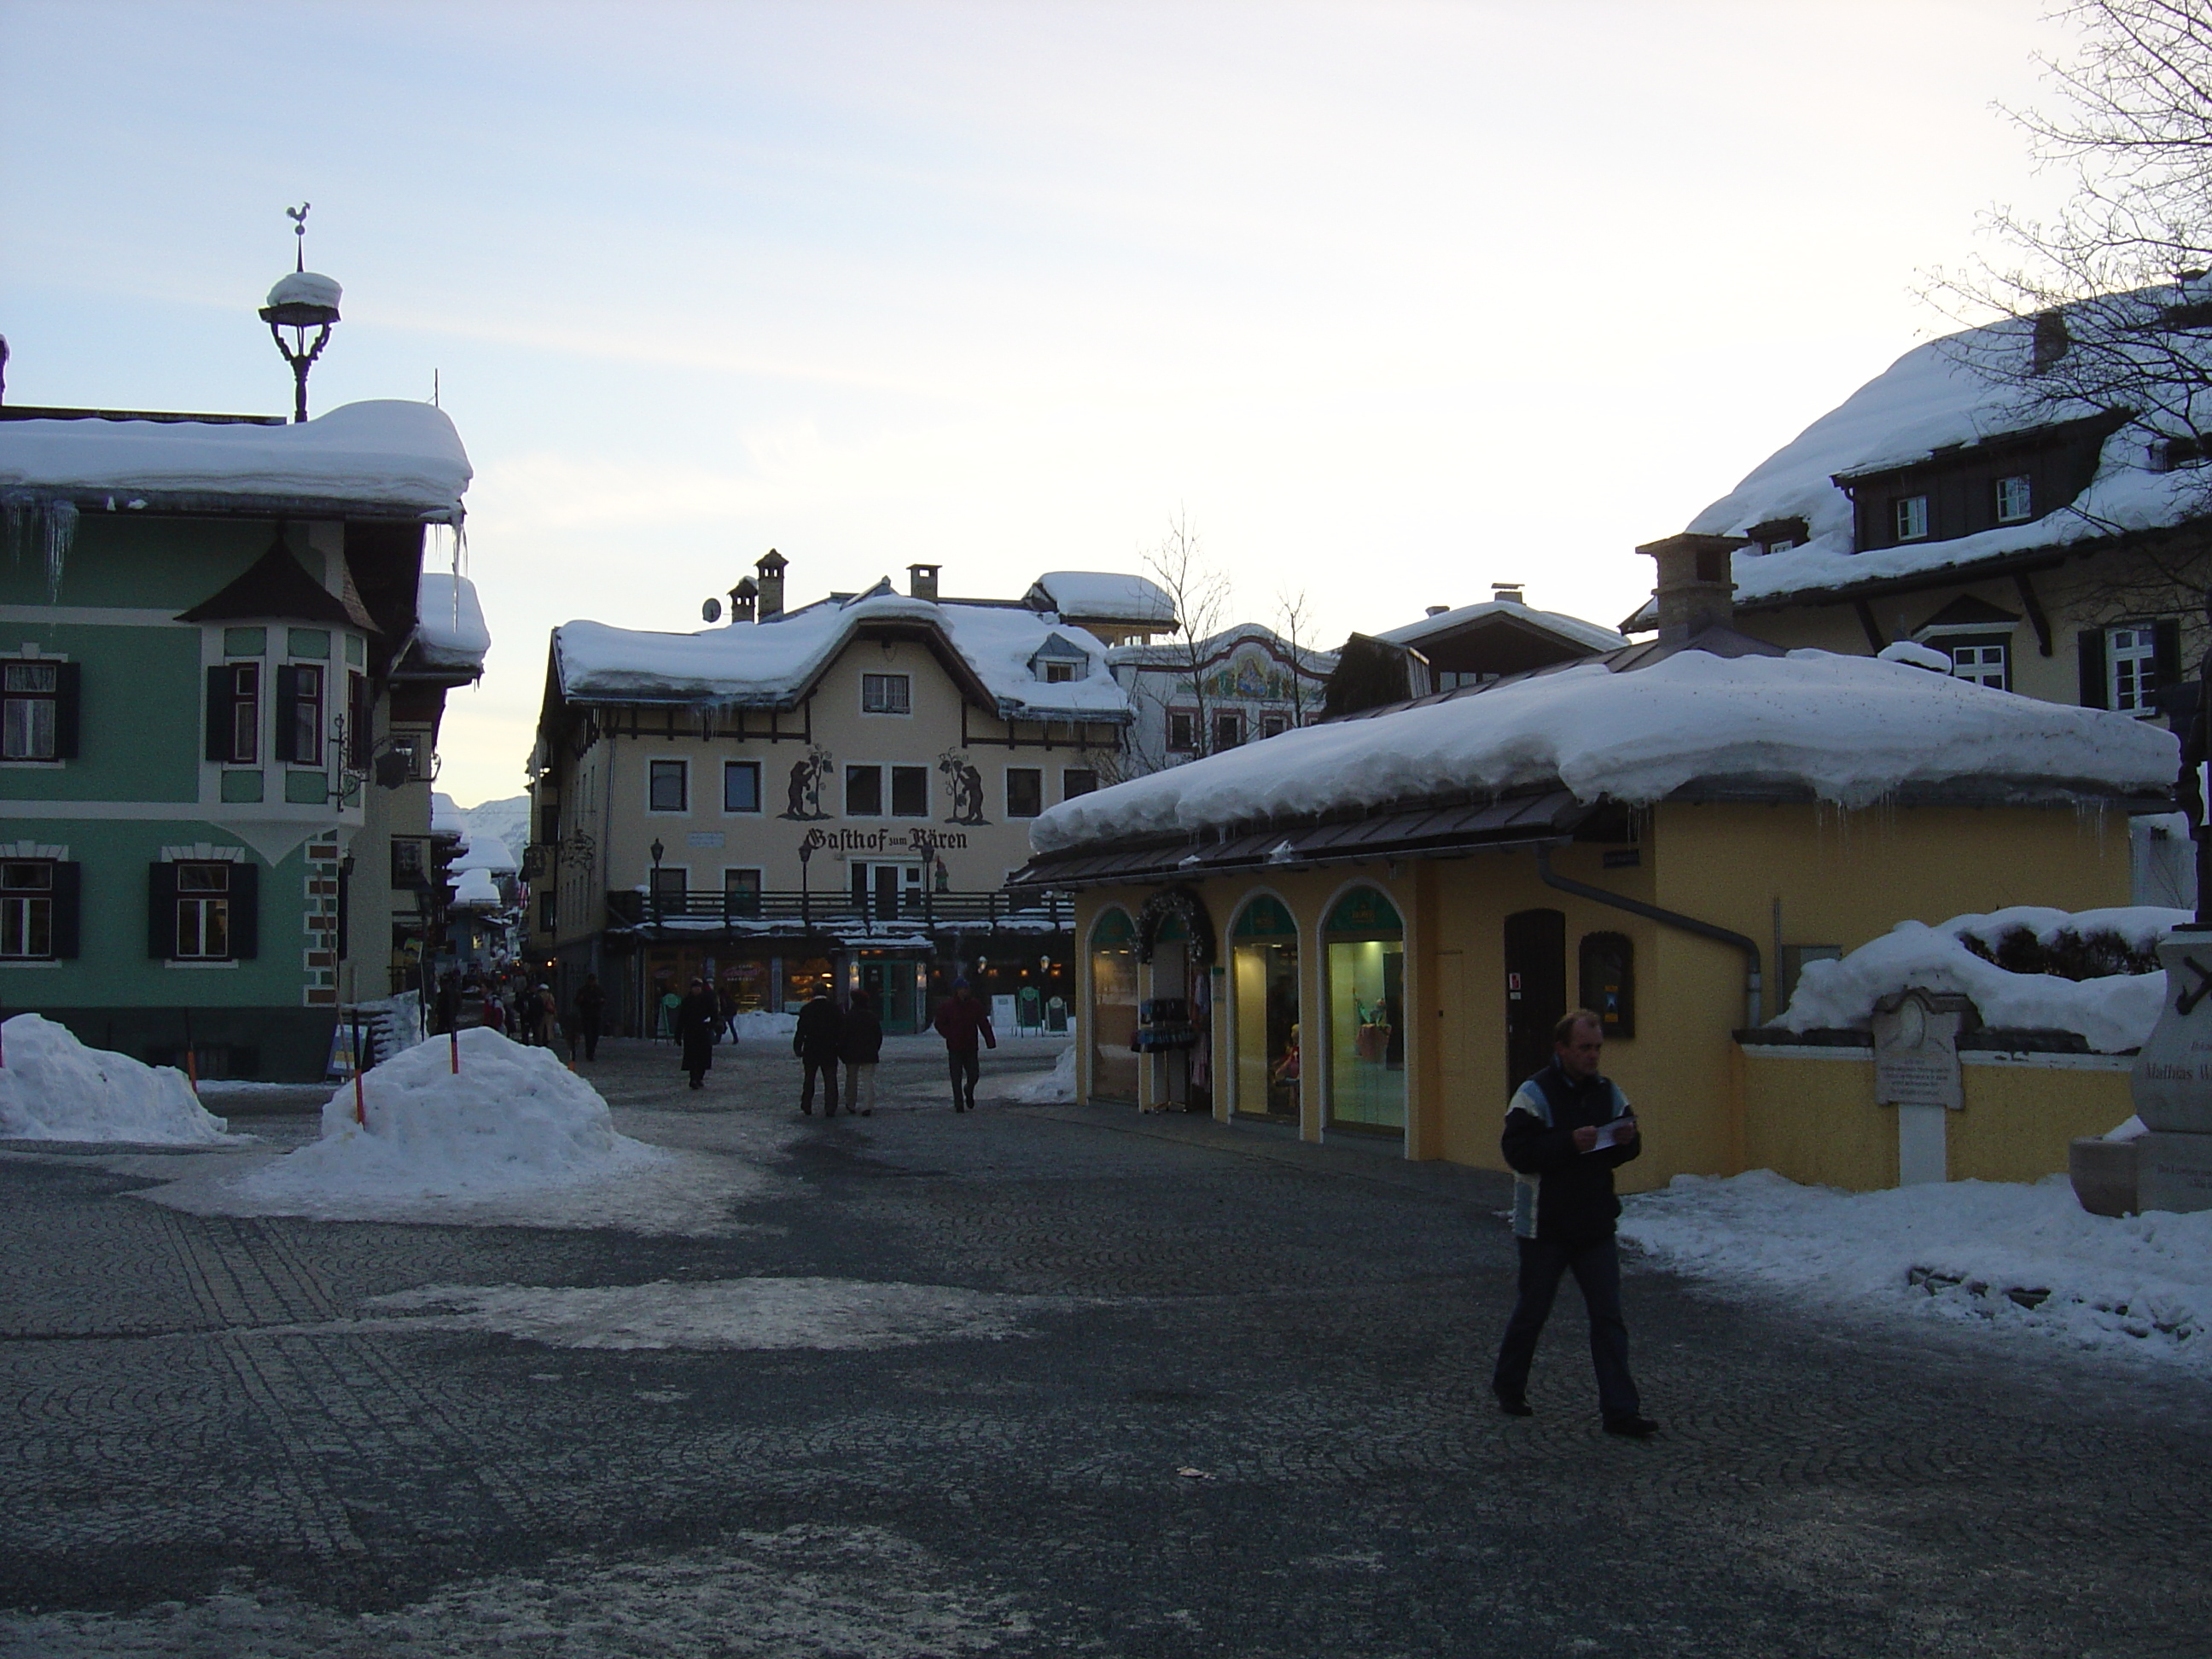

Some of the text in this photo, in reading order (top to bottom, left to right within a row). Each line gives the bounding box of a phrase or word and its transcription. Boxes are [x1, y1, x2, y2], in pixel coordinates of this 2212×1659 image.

[806, 828, 968, 852] Gasthof zum Bären
